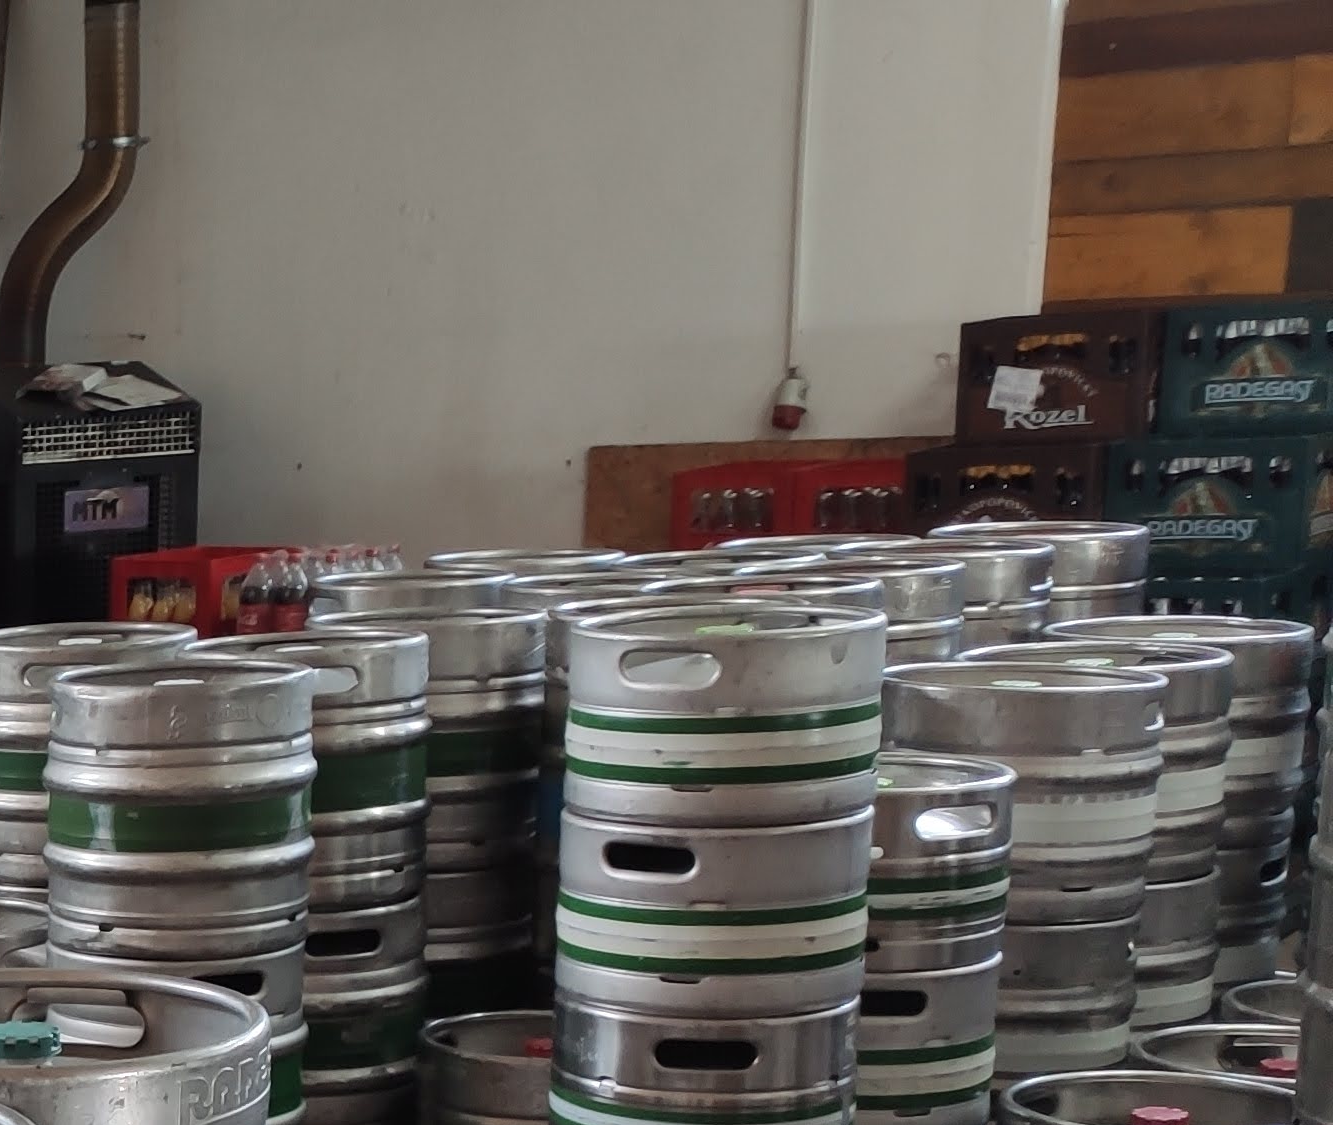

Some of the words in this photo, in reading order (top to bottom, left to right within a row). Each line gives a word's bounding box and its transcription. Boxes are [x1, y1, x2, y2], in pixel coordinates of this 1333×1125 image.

[1205, 380, 1317, 404] RADEGAST
[1004, 405, 1094, 430] Kozel
[72, 499, 120, 522] MTM
[1147, 519, 1258, 541] RADEGAST
